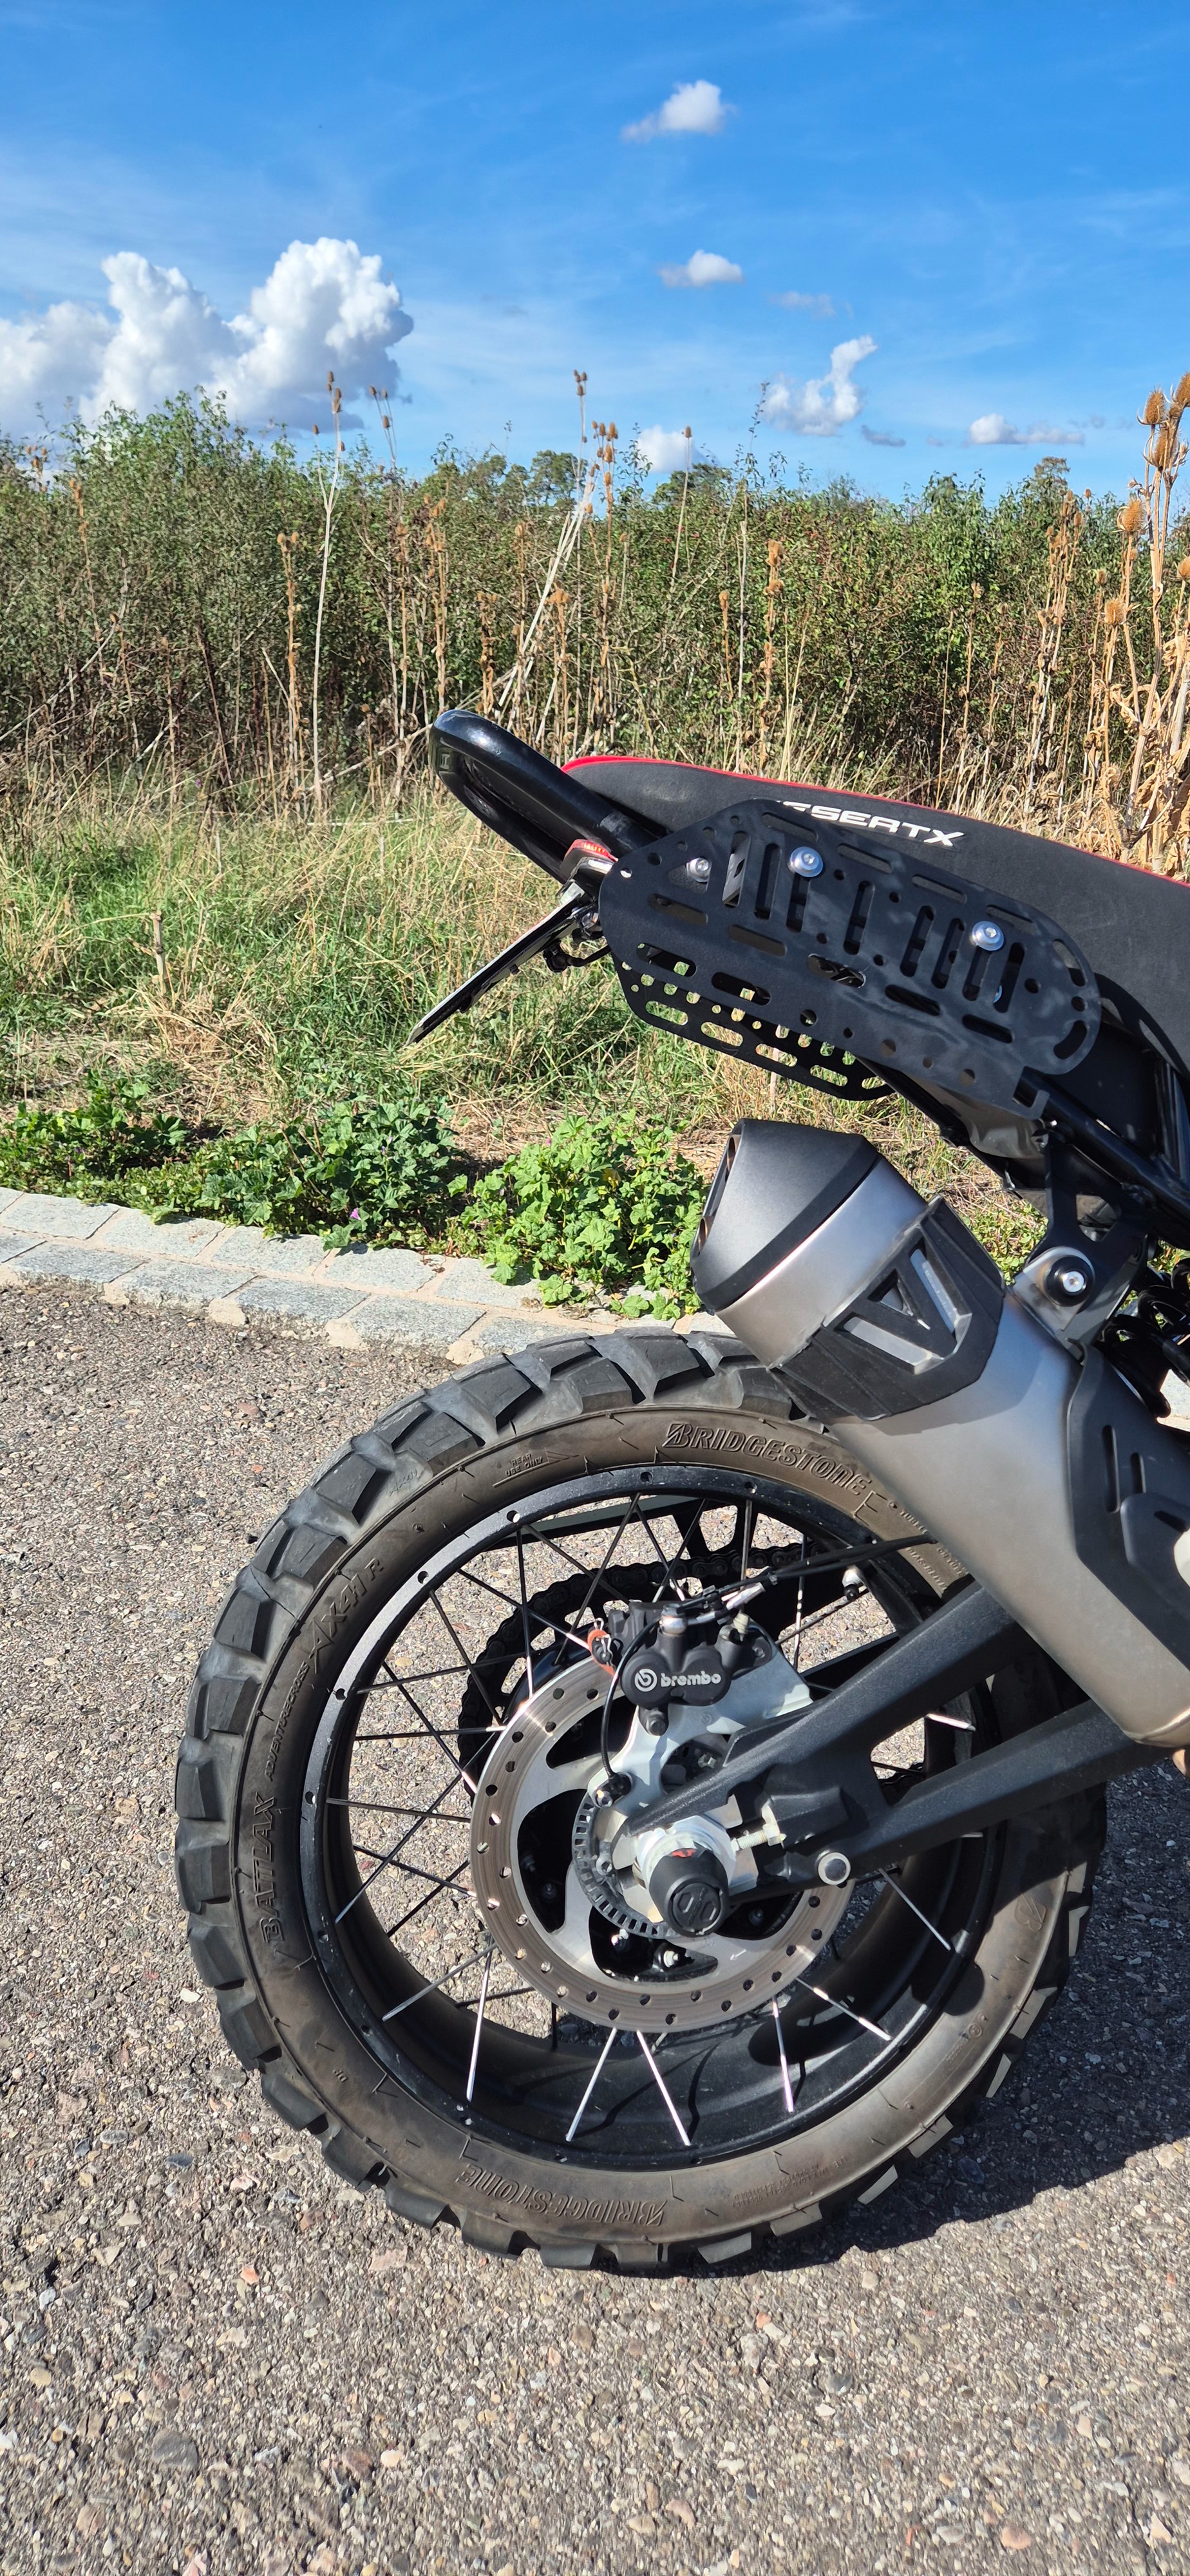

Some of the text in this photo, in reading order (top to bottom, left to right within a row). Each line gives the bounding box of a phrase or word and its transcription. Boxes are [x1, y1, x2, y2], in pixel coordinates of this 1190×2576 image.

[776, 800, 965, 847] SERTX
[505, 1457, 543, 1477] USE ONLY
[511, 1453, 532, 1466] REAR
[662, 1423, 873, 1496] BRIDGESTONE
[660, 1671, 722, 1688] brembo
[254, 1557, 384, 1944] BATTLAX ADVENTURECROSS AX41 R
[455, 2163, 668, 2227] BRIDGESTONE
